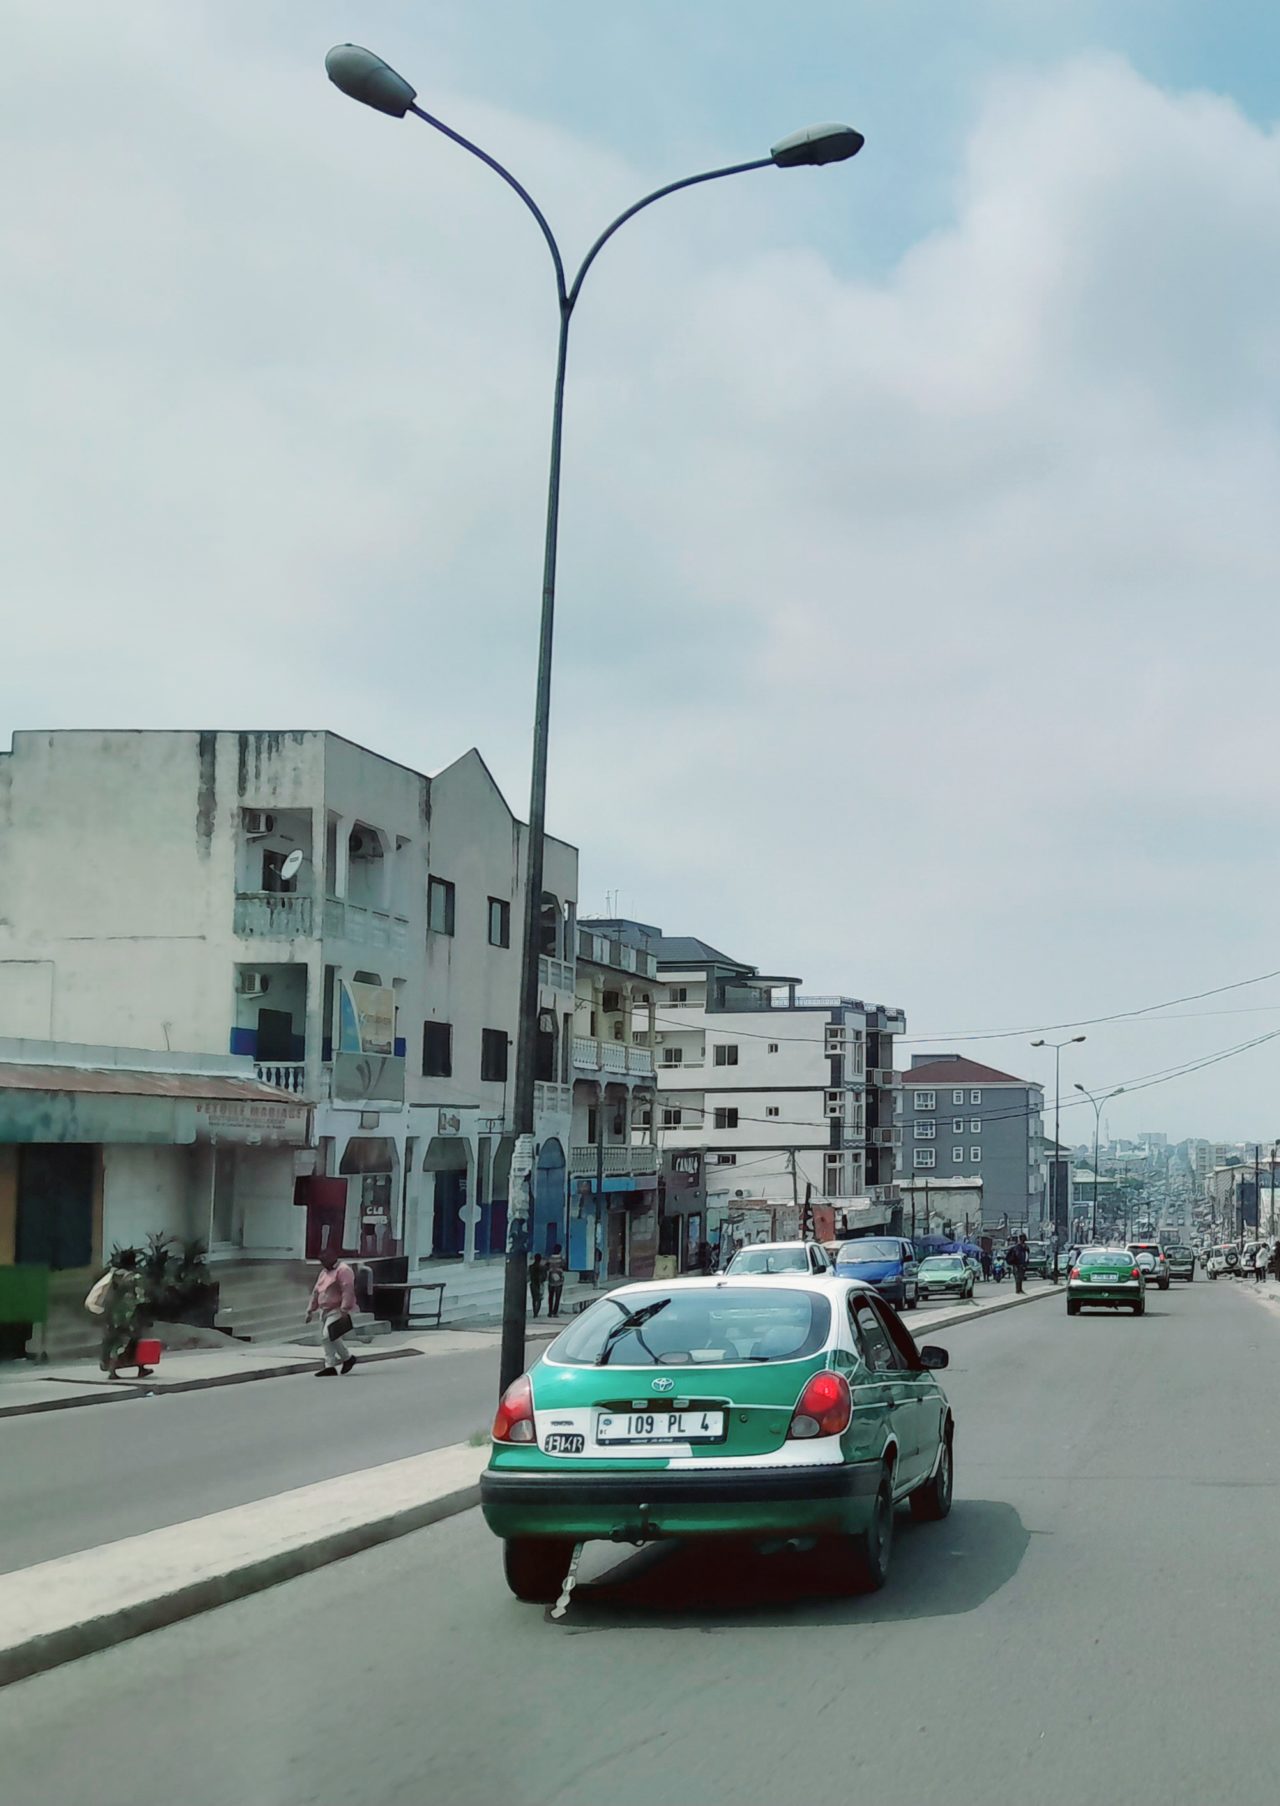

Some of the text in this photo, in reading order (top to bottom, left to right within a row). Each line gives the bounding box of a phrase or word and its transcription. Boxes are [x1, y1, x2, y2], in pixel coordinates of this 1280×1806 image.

[627, 1415, 655, 1435] 109
[668, 1414, 686, 1433] PL
[700, 1413, 709, 1432] 4
